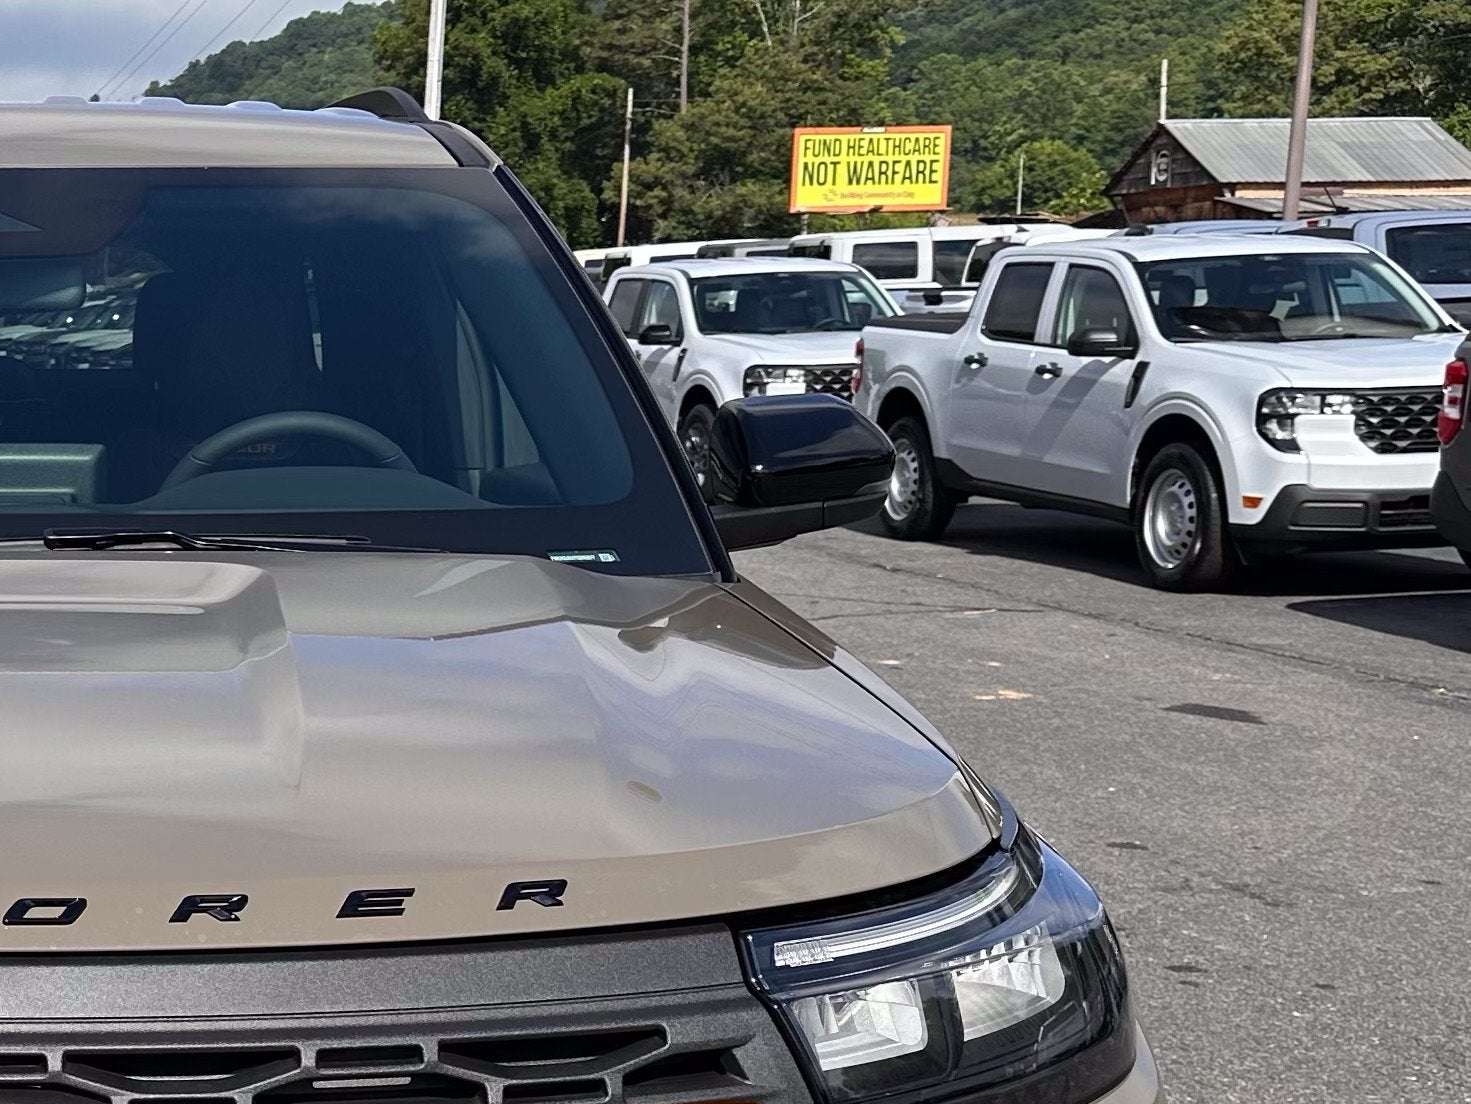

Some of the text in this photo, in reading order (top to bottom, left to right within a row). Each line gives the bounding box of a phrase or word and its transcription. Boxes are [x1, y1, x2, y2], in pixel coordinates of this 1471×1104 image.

[803, 136, 941, 158] FUND HEALTHCARE
[802, 159, 940, 186] NOT WARFARE
